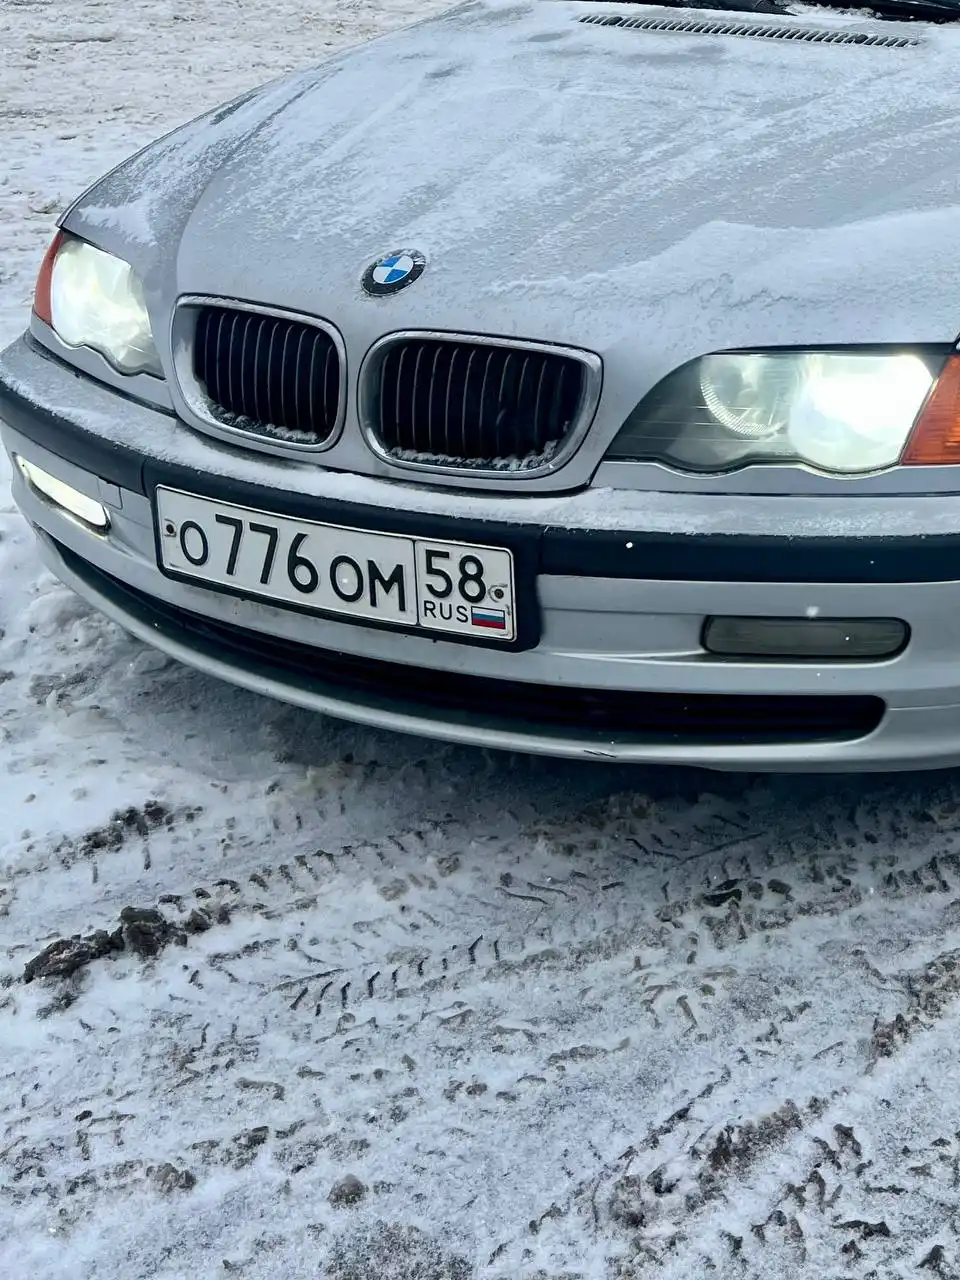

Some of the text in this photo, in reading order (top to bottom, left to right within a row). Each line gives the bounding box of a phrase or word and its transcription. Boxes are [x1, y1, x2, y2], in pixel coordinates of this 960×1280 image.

[179, 513, 487, 612] О776ОМ 58
[423, 599, 469, 624] RUS
